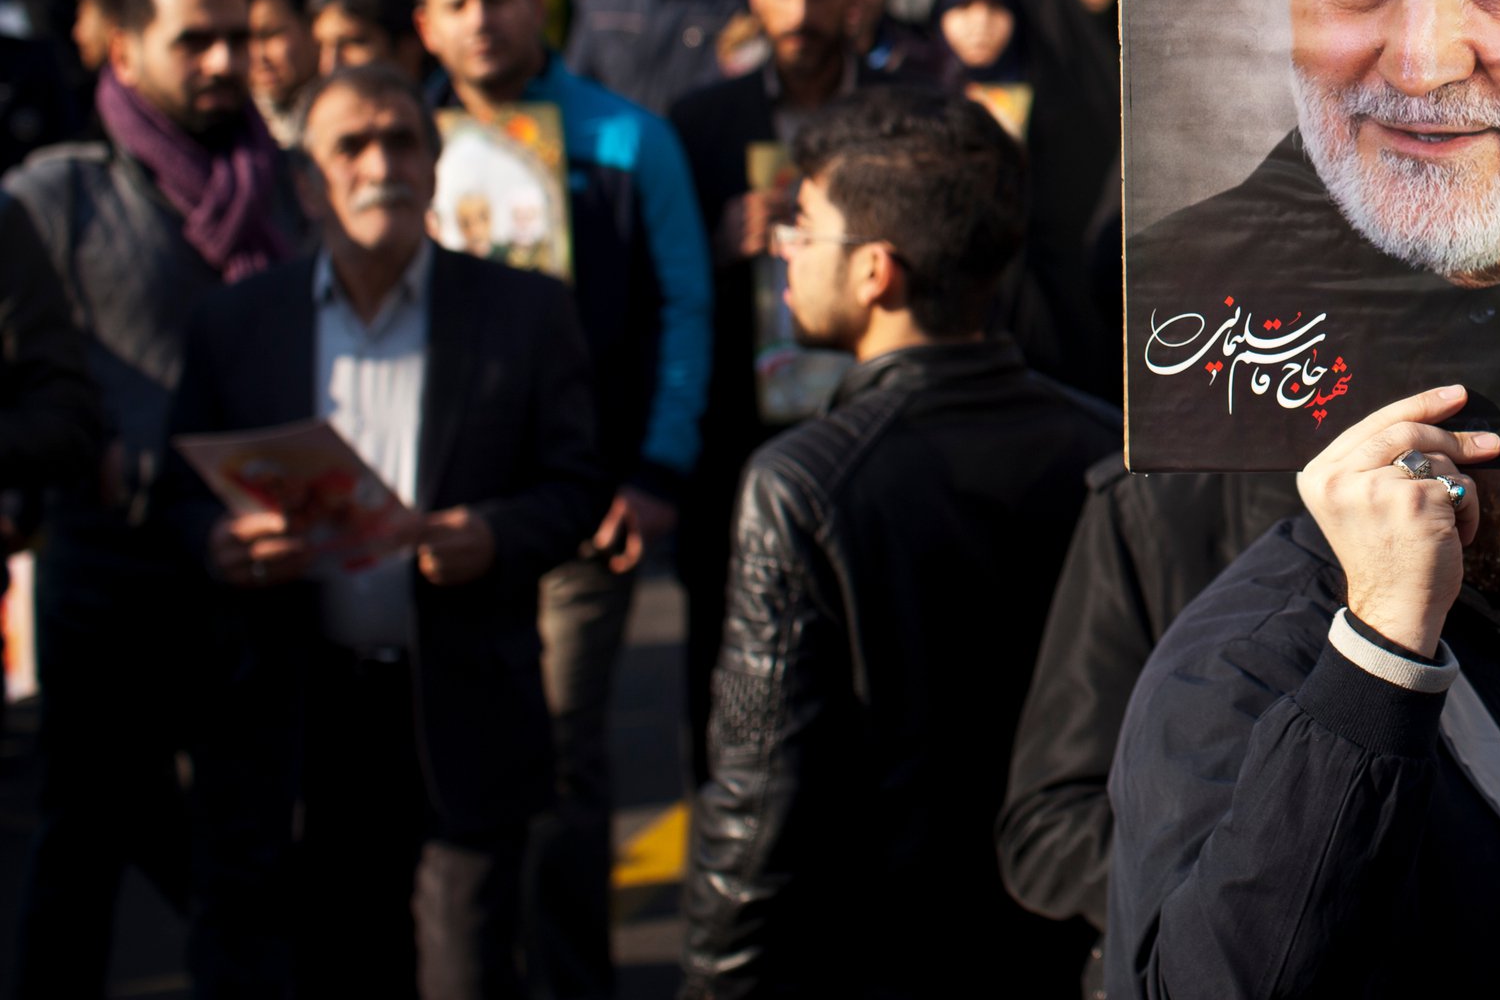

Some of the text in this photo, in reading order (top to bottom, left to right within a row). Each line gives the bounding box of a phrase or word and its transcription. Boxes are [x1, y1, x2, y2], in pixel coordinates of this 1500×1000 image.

[1144, 295, 1353, 430] شهید حاج قاسم سلیمانی
